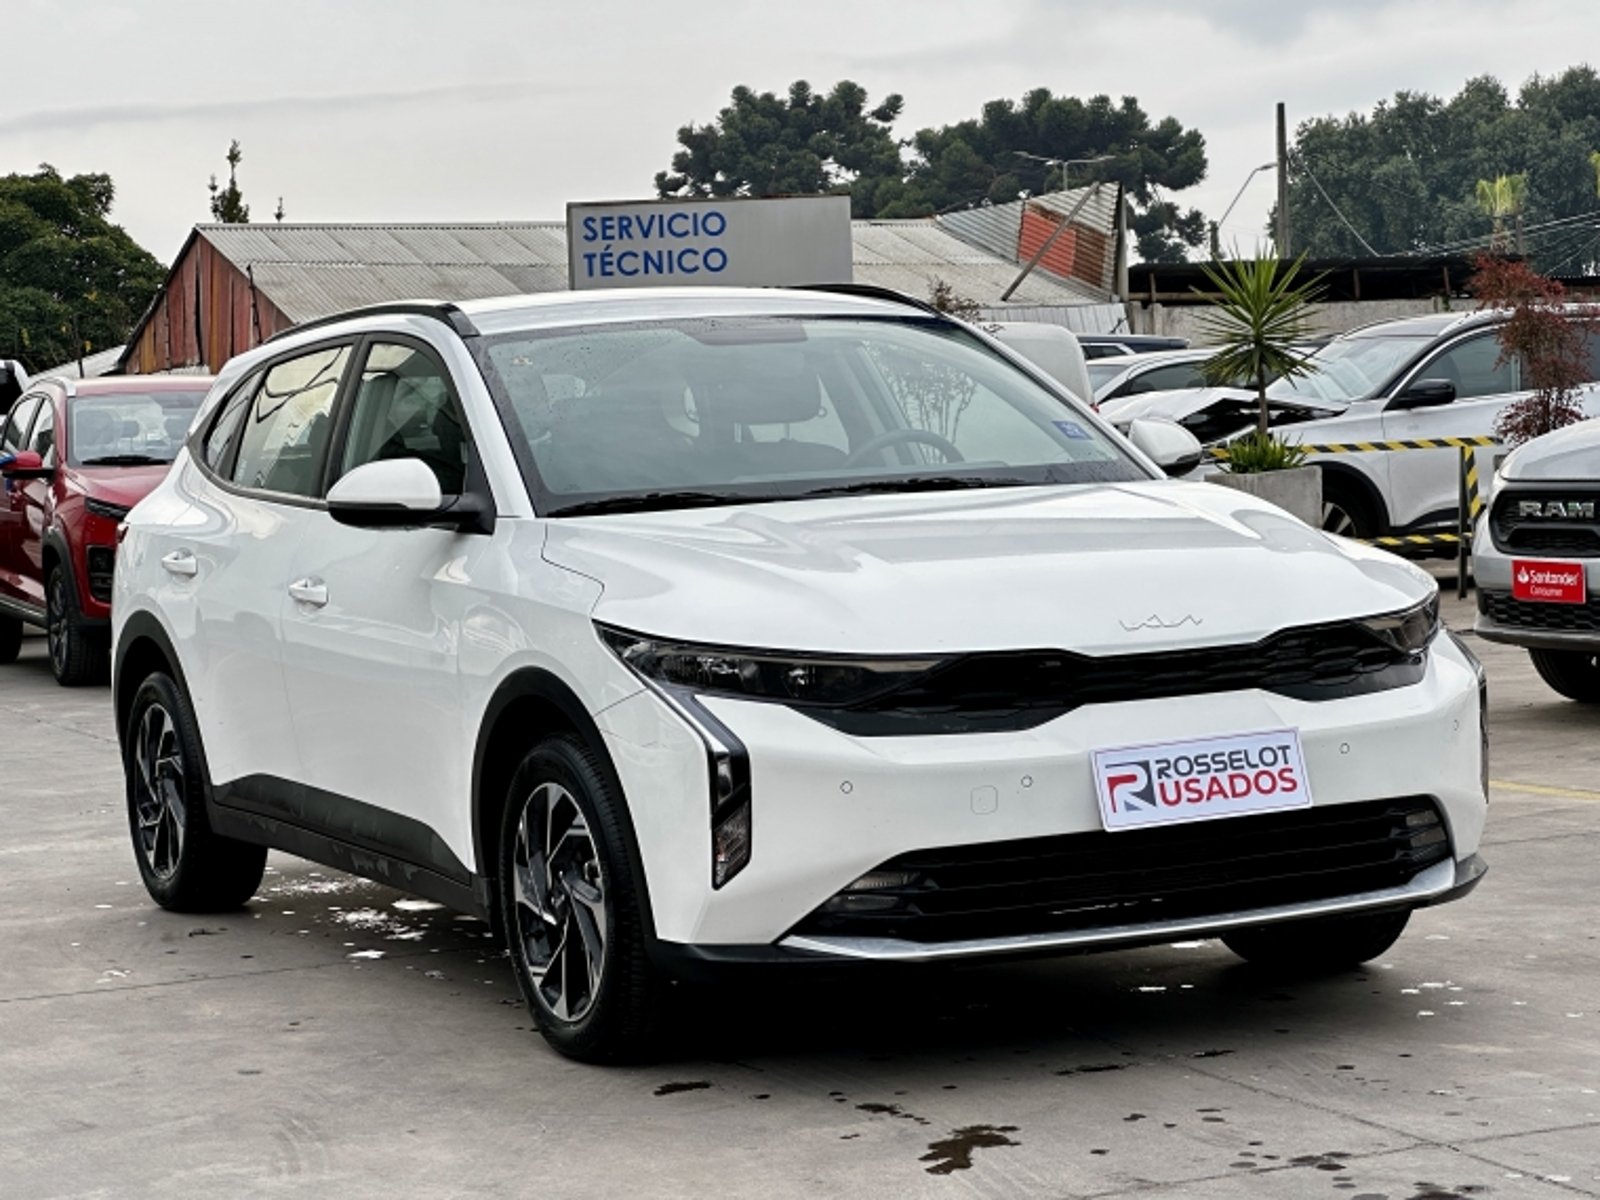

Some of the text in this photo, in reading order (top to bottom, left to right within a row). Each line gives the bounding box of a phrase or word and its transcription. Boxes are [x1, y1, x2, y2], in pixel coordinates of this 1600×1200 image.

[582, 211, 727, 241] SERVICIO
[582, 244, 728, 277] TÉCNICO
[1519, 501, 1595, 518] RAM
[1530, 569, 1577, 585] Santander
[1530, 585, 1563, 597] Consumer
[1155, 745, 1291, 780] ROSSELOT
[1158, 767, 1298, 807] USADOS
